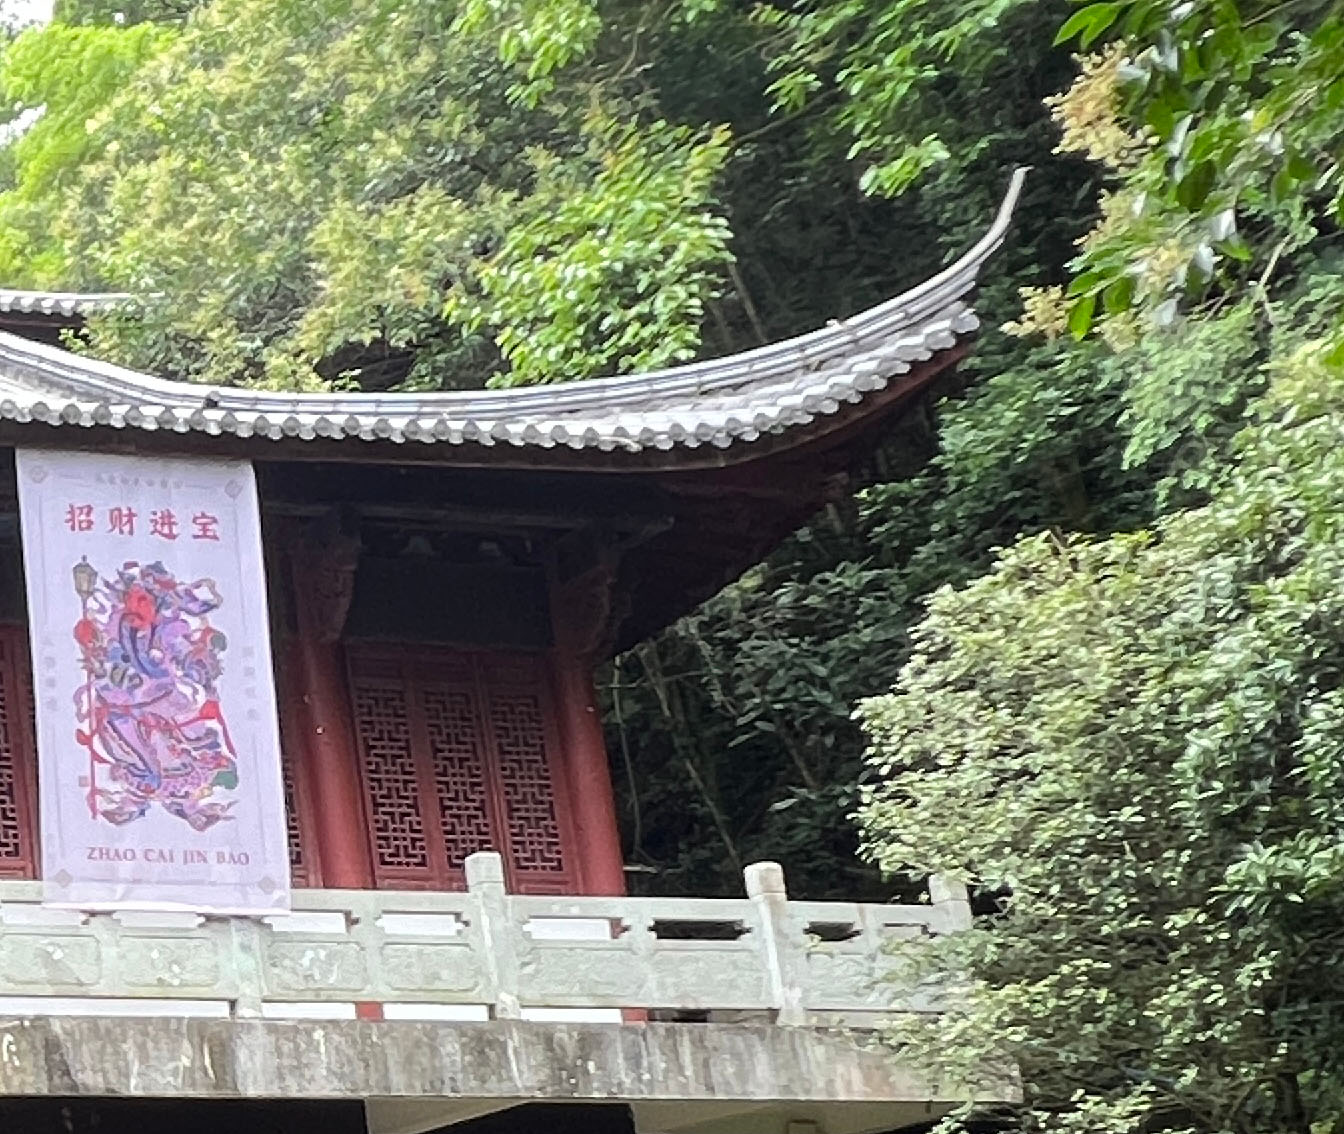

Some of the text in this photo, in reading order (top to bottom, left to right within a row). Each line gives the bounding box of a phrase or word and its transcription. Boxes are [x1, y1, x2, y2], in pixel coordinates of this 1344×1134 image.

[64, 503, 220, 541] 招财进宝
[86, 846, 250, 866] ZHAO CAI JIN BAO
